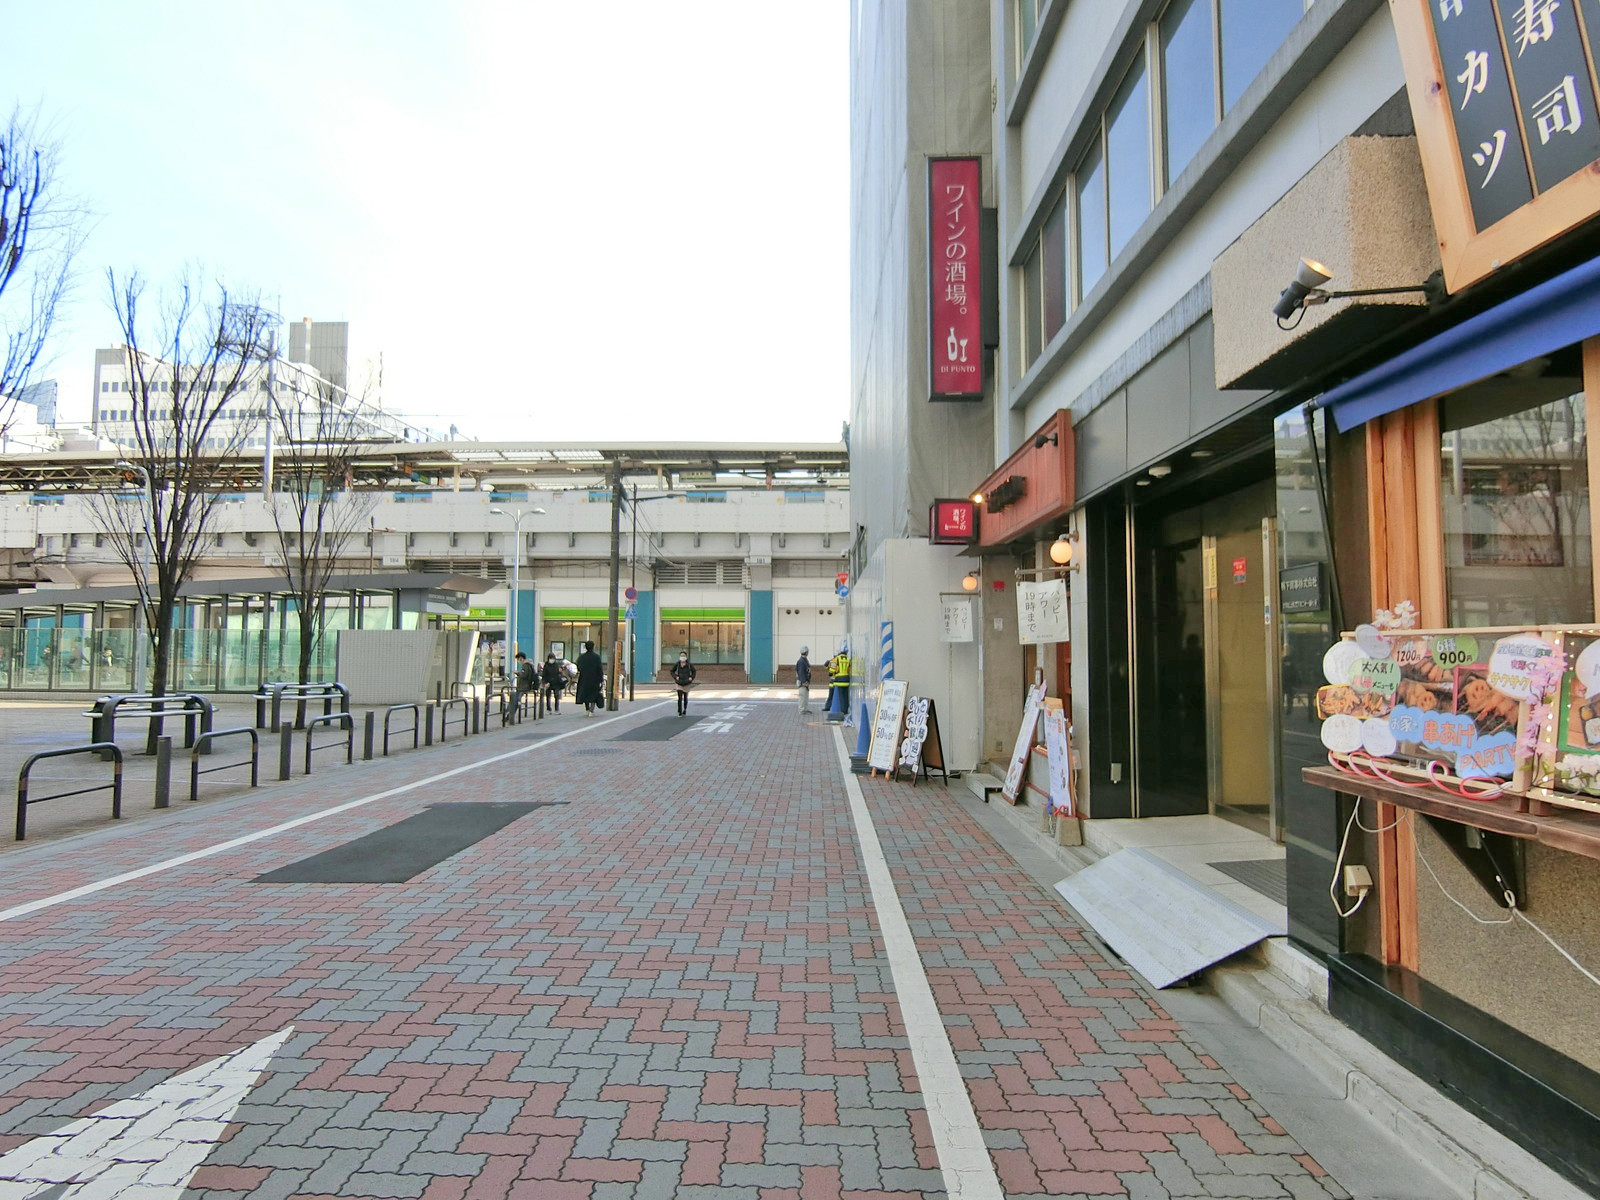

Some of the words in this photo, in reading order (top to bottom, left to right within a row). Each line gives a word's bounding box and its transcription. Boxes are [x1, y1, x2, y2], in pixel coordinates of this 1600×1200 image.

[1512, 0, 1583, 146] 寿司
[944, 184, 968, 316] ワインの酒場。
[940, 365, 949, 373] DI
[950, 365, 976, 373] PUNTO
[1024, 591, 1037, 633] 19時まで
[1038, 591, 1048, 619] アワー
[1050, 590, 1061, 624] ハッピー
[1439, 650, 1473, 665] 900円
[1423, 719, 1476, 748] 串あげ
[1460, 742, 1517, 771] PARTY
